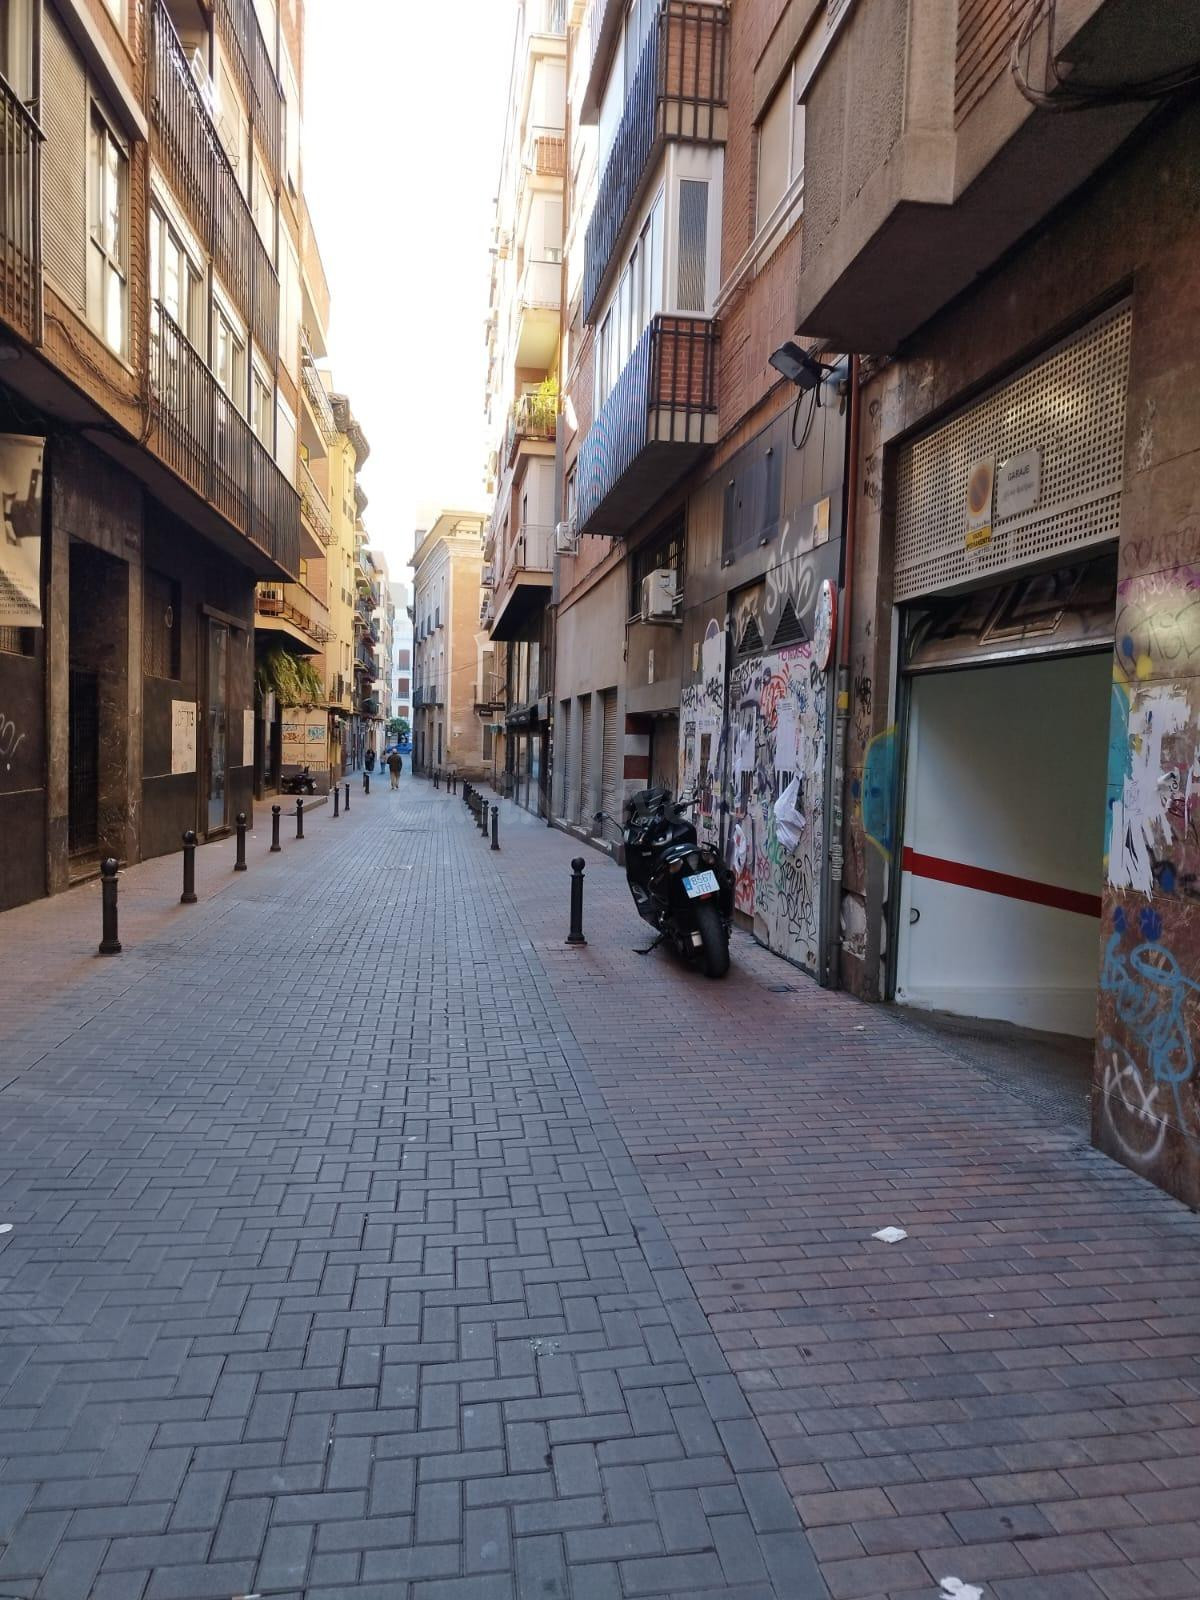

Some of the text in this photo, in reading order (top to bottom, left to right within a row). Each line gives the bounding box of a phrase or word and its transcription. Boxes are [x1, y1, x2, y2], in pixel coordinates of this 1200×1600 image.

[1007, 464, 1030, 481] GARAJE
[690, 871, 713, 885] 8567
[696, 883, 712, 894] JTH
